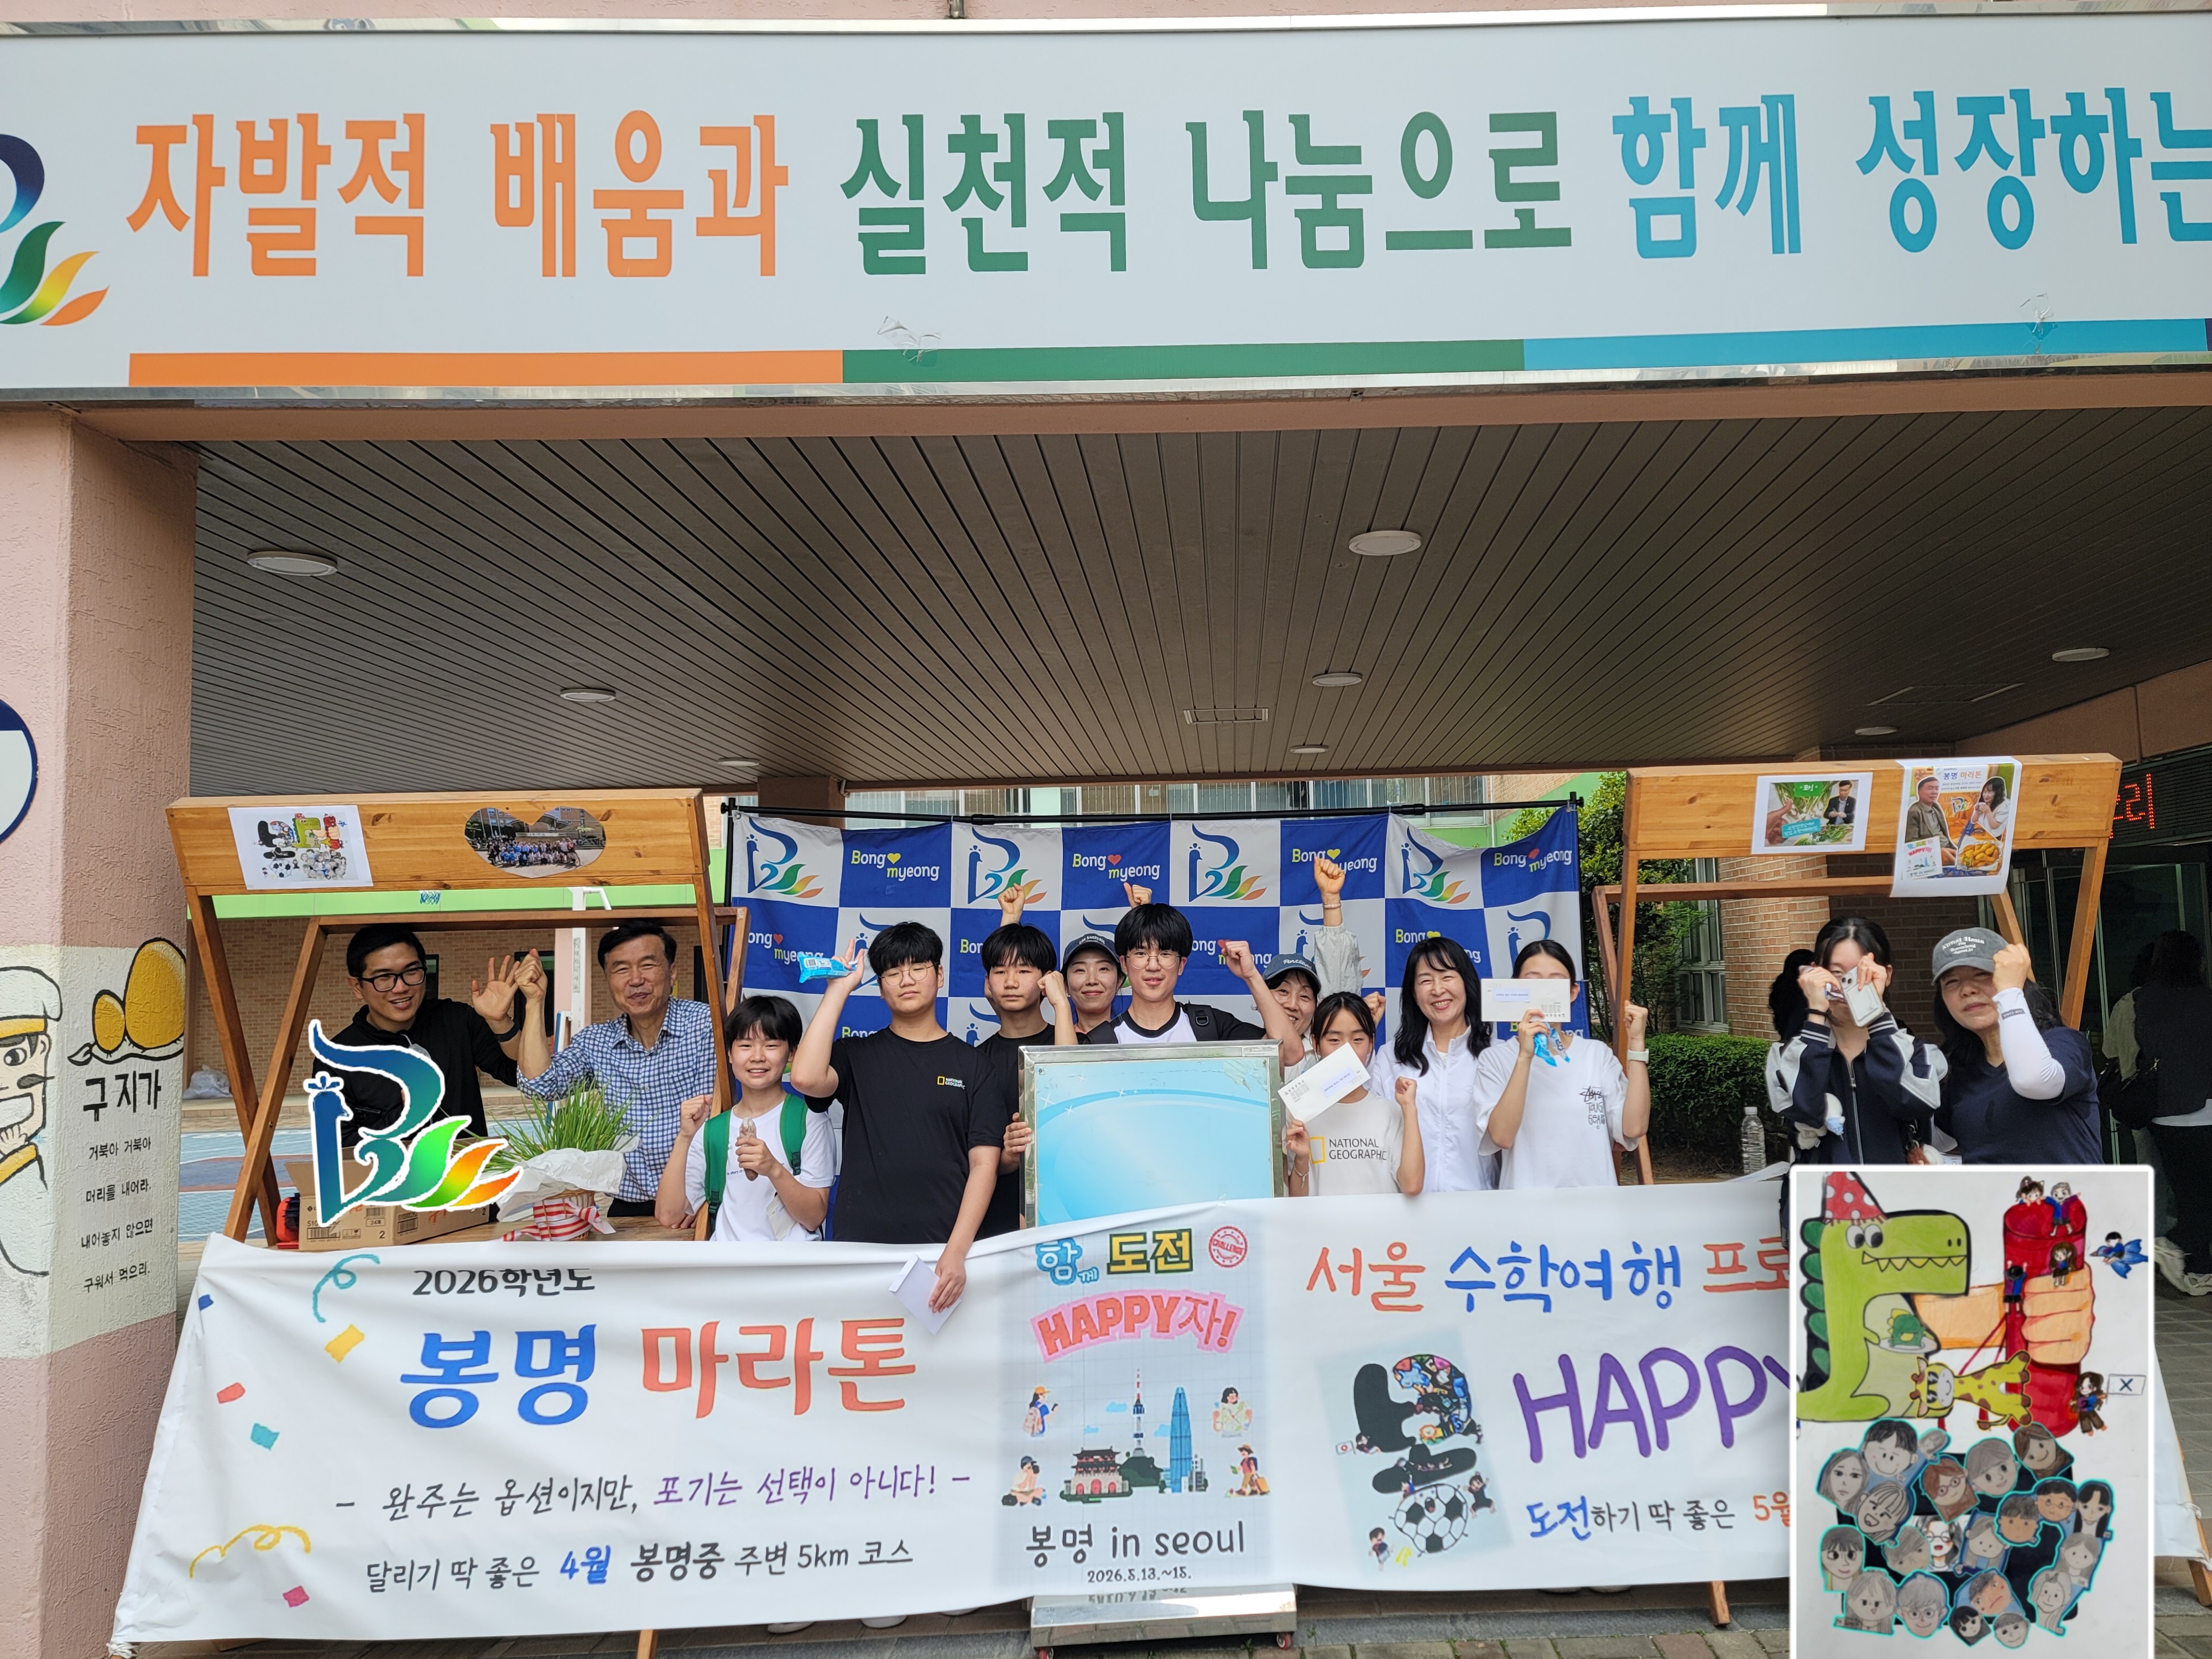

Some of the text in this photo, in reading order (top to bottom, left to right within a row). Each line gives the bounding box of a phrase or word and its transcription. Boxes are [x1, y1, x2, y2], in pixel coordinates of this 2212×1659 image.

[126, 87, 2212, 278] 자발적 배움과 실천적 나눔으로 함께 성장하는
[851, 850, 886, 868] Bong
[1072, 853, 1106, 871] Bong
[1335, 857, 1378, 874] yeong
[1494, 852, 1527, 867] Bong
[1528, 849, 1572, 873] myeong
[886, 865, 940, 882] myeong
[1108, 864, 1160, 882] myeong
[748, 932, 773, 949] ong
[1192, 940, 1216, 955] ong
[83, 1069, 161, 1122] 구지가
[89, 1136, 151, 1160] 거북아 거북아
[1329, 1138, 1379, 1149] NATIONAL
[1329, 1149, 1387, 1161] GEOGRAPHIC
[86, 1178, 151, 1203] 머리를 내어라.
[81, 1217, 153, 1249] 내어놓지 않으면
[379, 1230, 385, 1239] 2
[1036, 1229, 1192, 1285] 함께 도전
[84, 1261, 150, 1293] 구워서 먹으리.
[412, 1268, 596, 1298] 2026학년도
[1306, 1241, 1426, 1312] 서울
[1444, 1240, 1681, 1313] 수학여행
[1037, 1294, 1237, 1356] HAPPY자!
[400, 1317, 916, 1429] 봉명 마라톤
[382, 1482, 480, 1522] 완주는
[494, 1474, 638, 1516] 옵션이지만,
[654, 1471, 743, 1506] 포기는
[757, 1466, 836, 1505] 선택이
[850, 1464, 936, 1499] 아니다!
[1526, 1495, 1641, 1541] 도전하기
[1648, 1500, 1676, 1531] 딱
[1683, 1499, 1736, 1531] 좋은
[1026, 1521, 1244, 1568] 봉명 in seoul
[367, 1539, 914, 1593] 달리기 딱 좋은 4월 봉명중 주변 5km 코스
[1087, 1566, 1192, 1584] 2026.5.13.~15.
